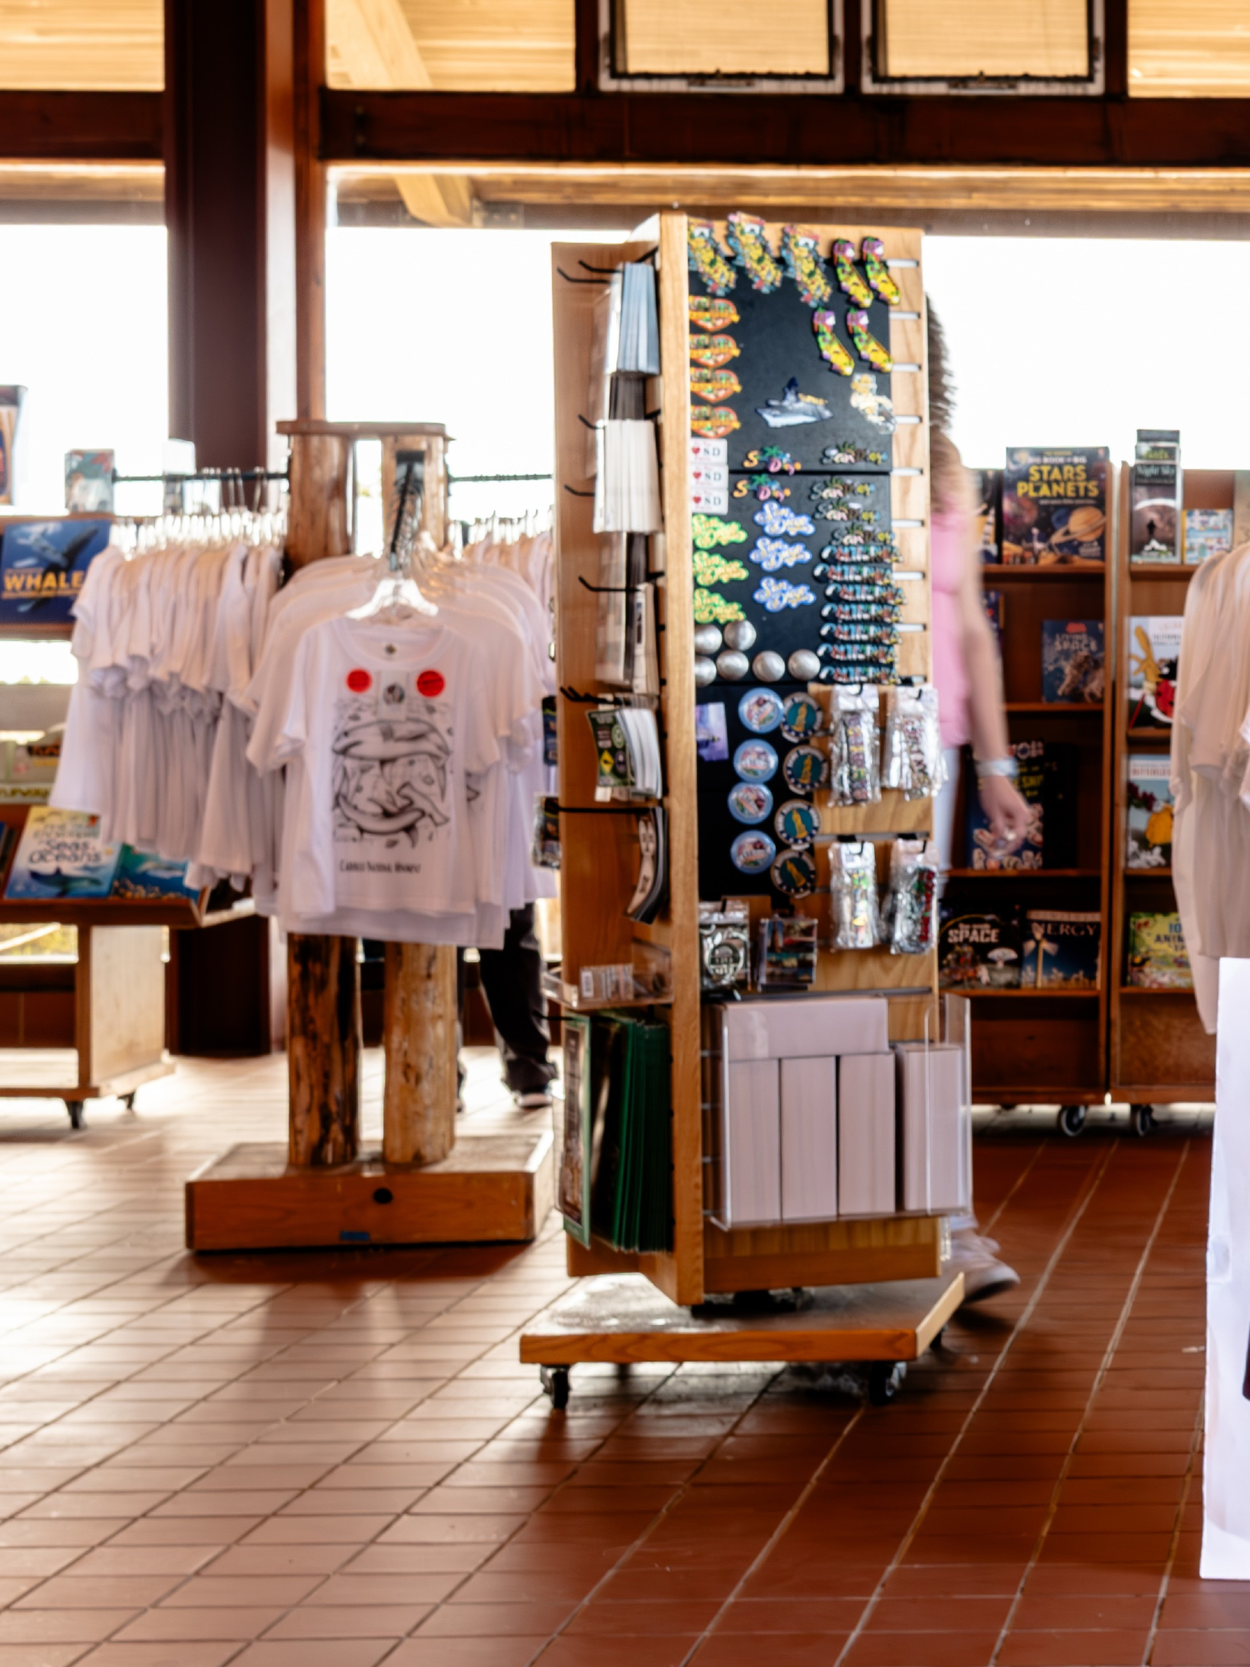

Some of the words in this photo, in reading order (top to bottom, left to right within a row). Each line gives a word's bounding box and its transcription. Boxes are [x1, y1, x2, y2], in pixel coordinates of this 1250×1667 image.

[1029, 464, 1087, 482] STARS
[1017, 481, 1099, 498] PLANETS
[948, 928, 1000, 943] SPACE
[1029, 922, 1097, 936] NERGY
